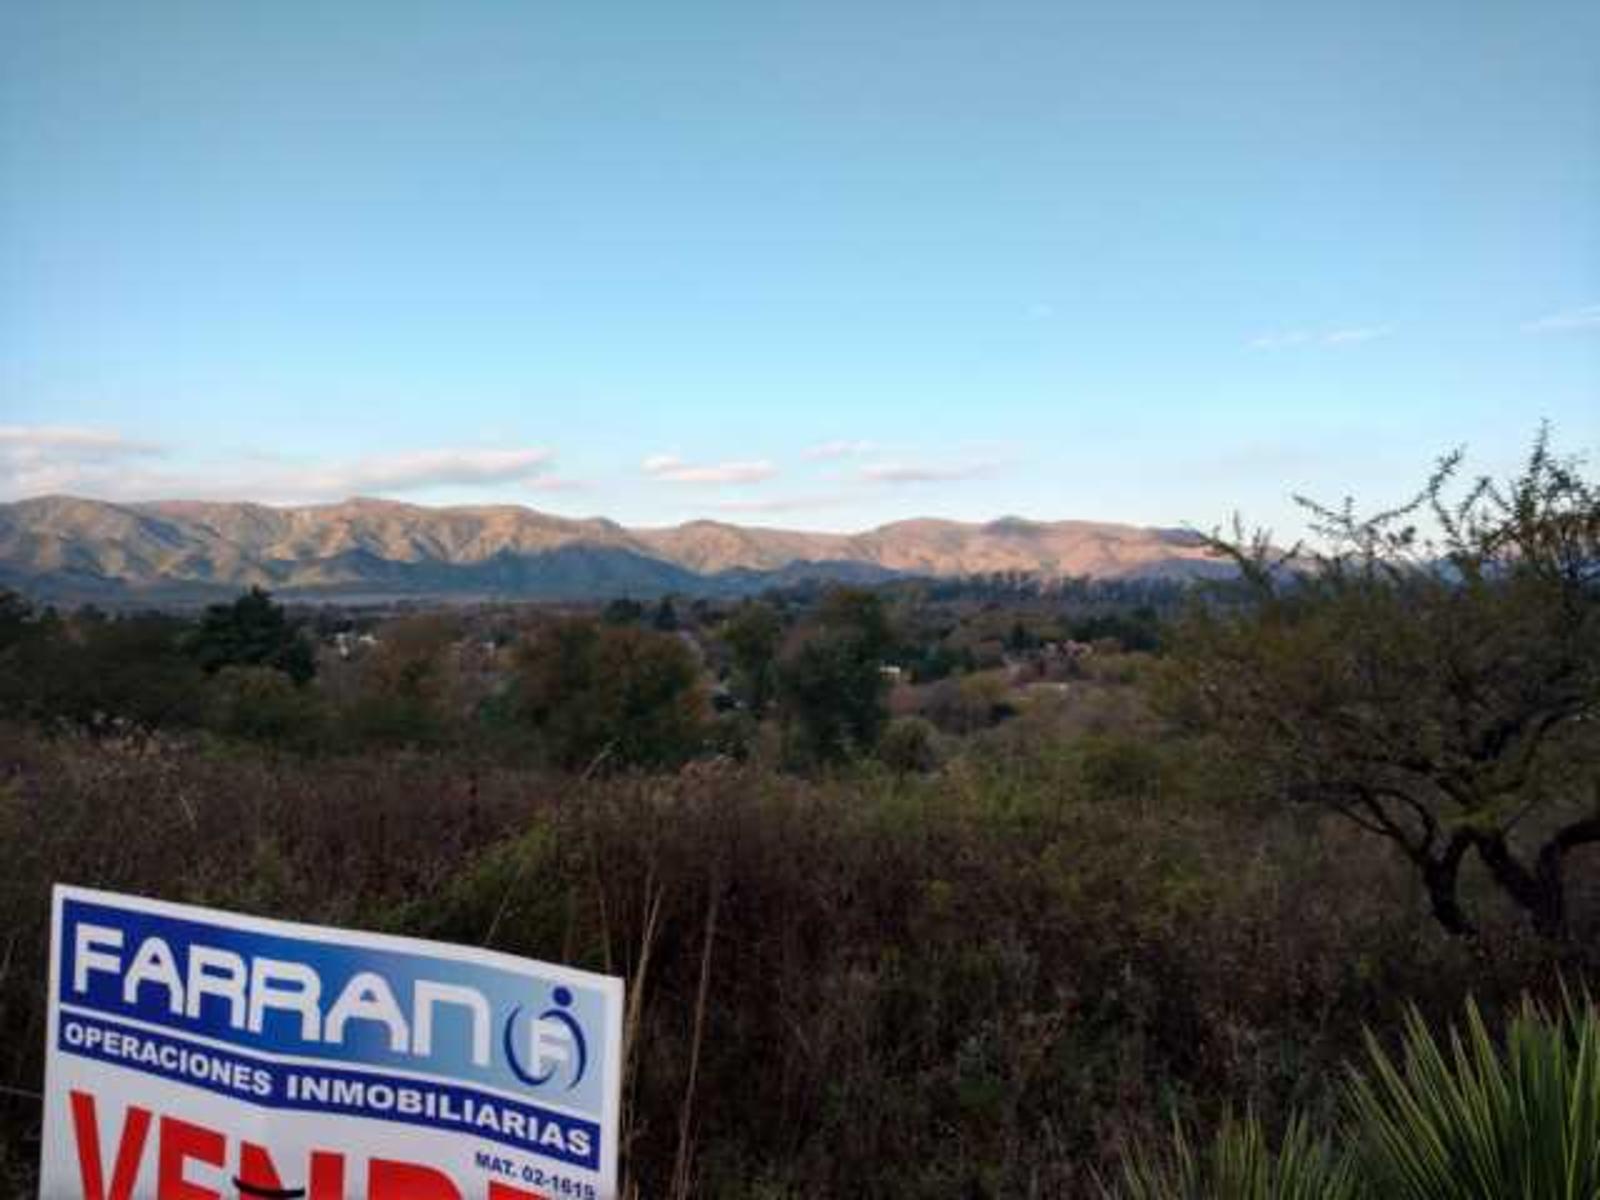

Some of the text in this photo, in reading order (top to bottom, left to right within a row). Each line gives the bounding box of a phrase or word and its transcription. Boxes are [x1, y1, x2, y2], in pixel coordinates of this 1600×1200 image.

[65, 1022, 273, 1096] OPERACIONES
[286, 1074, 591, 1155] INMOBILIARIAS
[475, 1152, 516, 1177] MAT.
